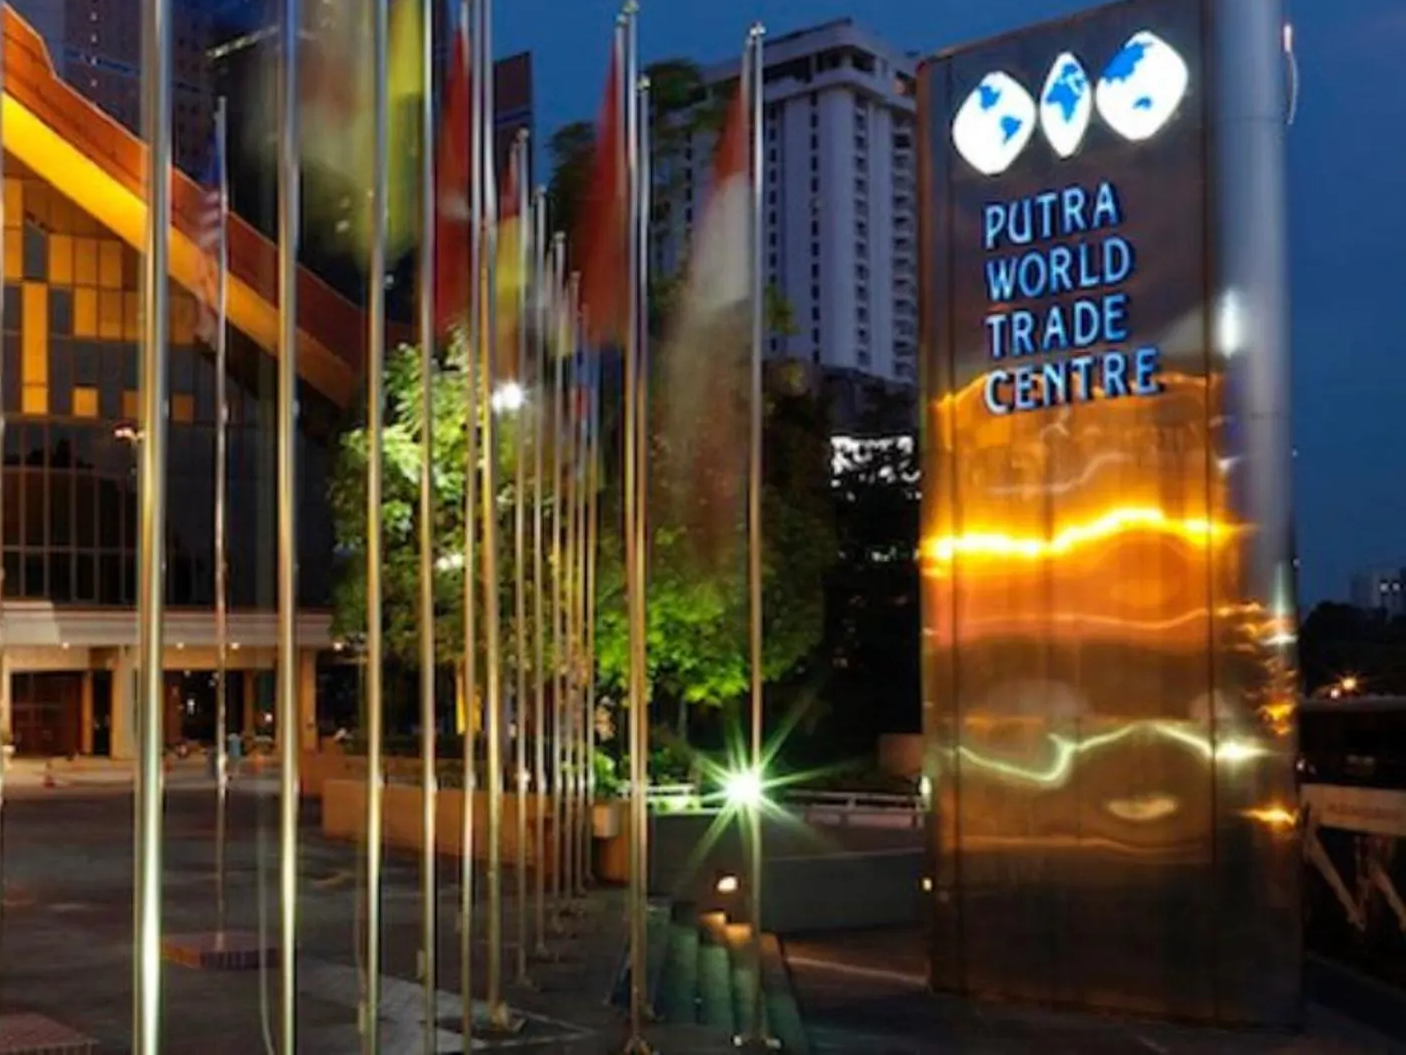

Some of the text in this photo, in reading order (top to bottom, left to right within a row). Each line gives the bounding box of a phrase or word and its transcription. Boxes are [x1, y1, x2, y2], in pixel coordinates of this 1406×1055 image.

[984, 181, 1119, 249] PUTRA
[985, 236, 1131, 301] WORLD
[985, 295, 1128, 357] TRADE
[984, 347, 1159, 414] CENTRE
